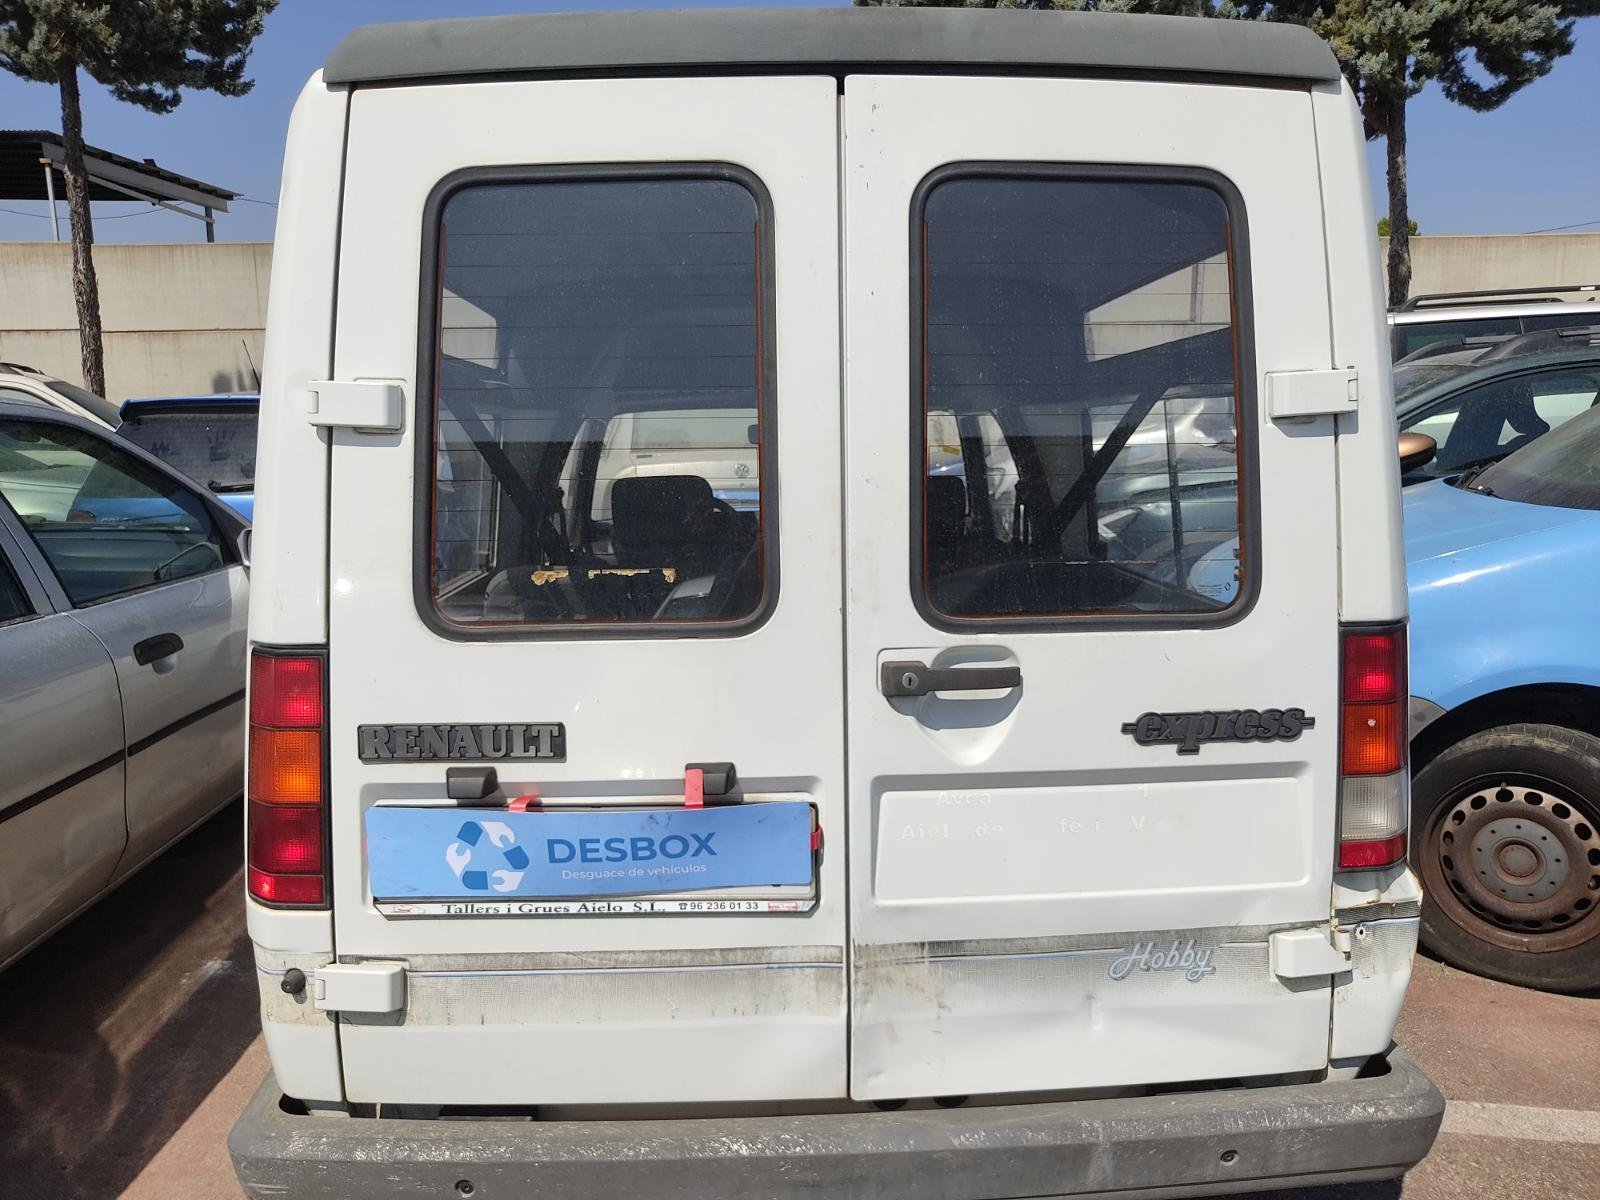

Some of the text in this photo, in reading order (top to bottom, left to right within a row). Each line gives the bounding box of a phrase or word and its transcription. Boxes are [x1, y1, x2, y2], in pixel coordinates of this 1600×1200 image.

[360, 725, 560, 758] RENAULT
[1135, 708, 1306, 753] express
[547, 832, 718, 864] DESBOX
[562, 869, 626, 881] Desguace
[628, 867, 645, 877] de
[442, 903, 501, 914] Tallers
[506, 903, 512, 914] i
[518, 903, 571, 914] Grues
[577, 902, 624, 913] Aielo
[690, 902, 703, 910] 96
[706, 902, 727, 910] 236
[729, 901, 741, 910] 01
[745, 901, 759, 910] 33
[1109, 939, 1216, 981] Hobby
